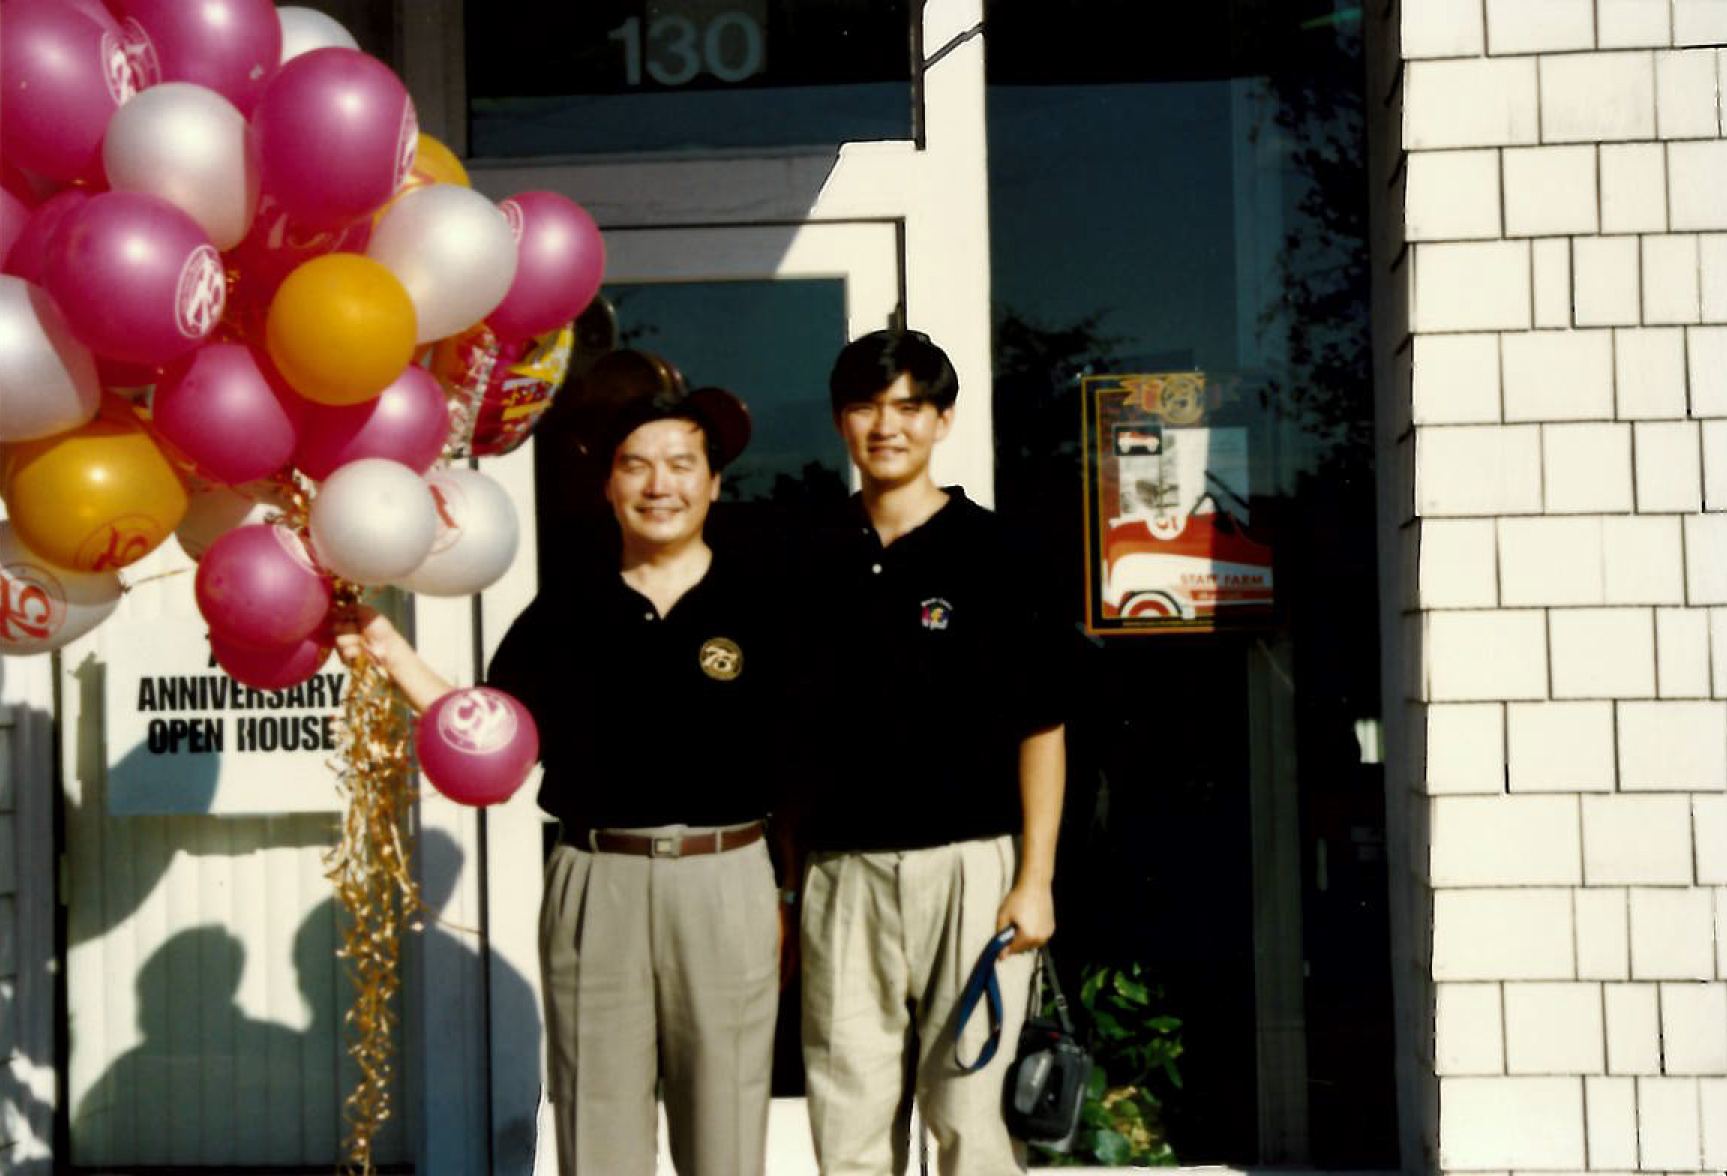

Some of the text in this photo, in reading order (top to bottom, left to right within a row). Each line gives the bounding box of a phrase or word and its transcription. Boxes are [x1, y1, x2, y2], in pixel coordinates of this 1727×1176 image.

[606, 12, 763, 84] 130
[138, 674, 345, 711] ANNIVERSARY
[148, 715, 336, 754] OPEN HOUSE
